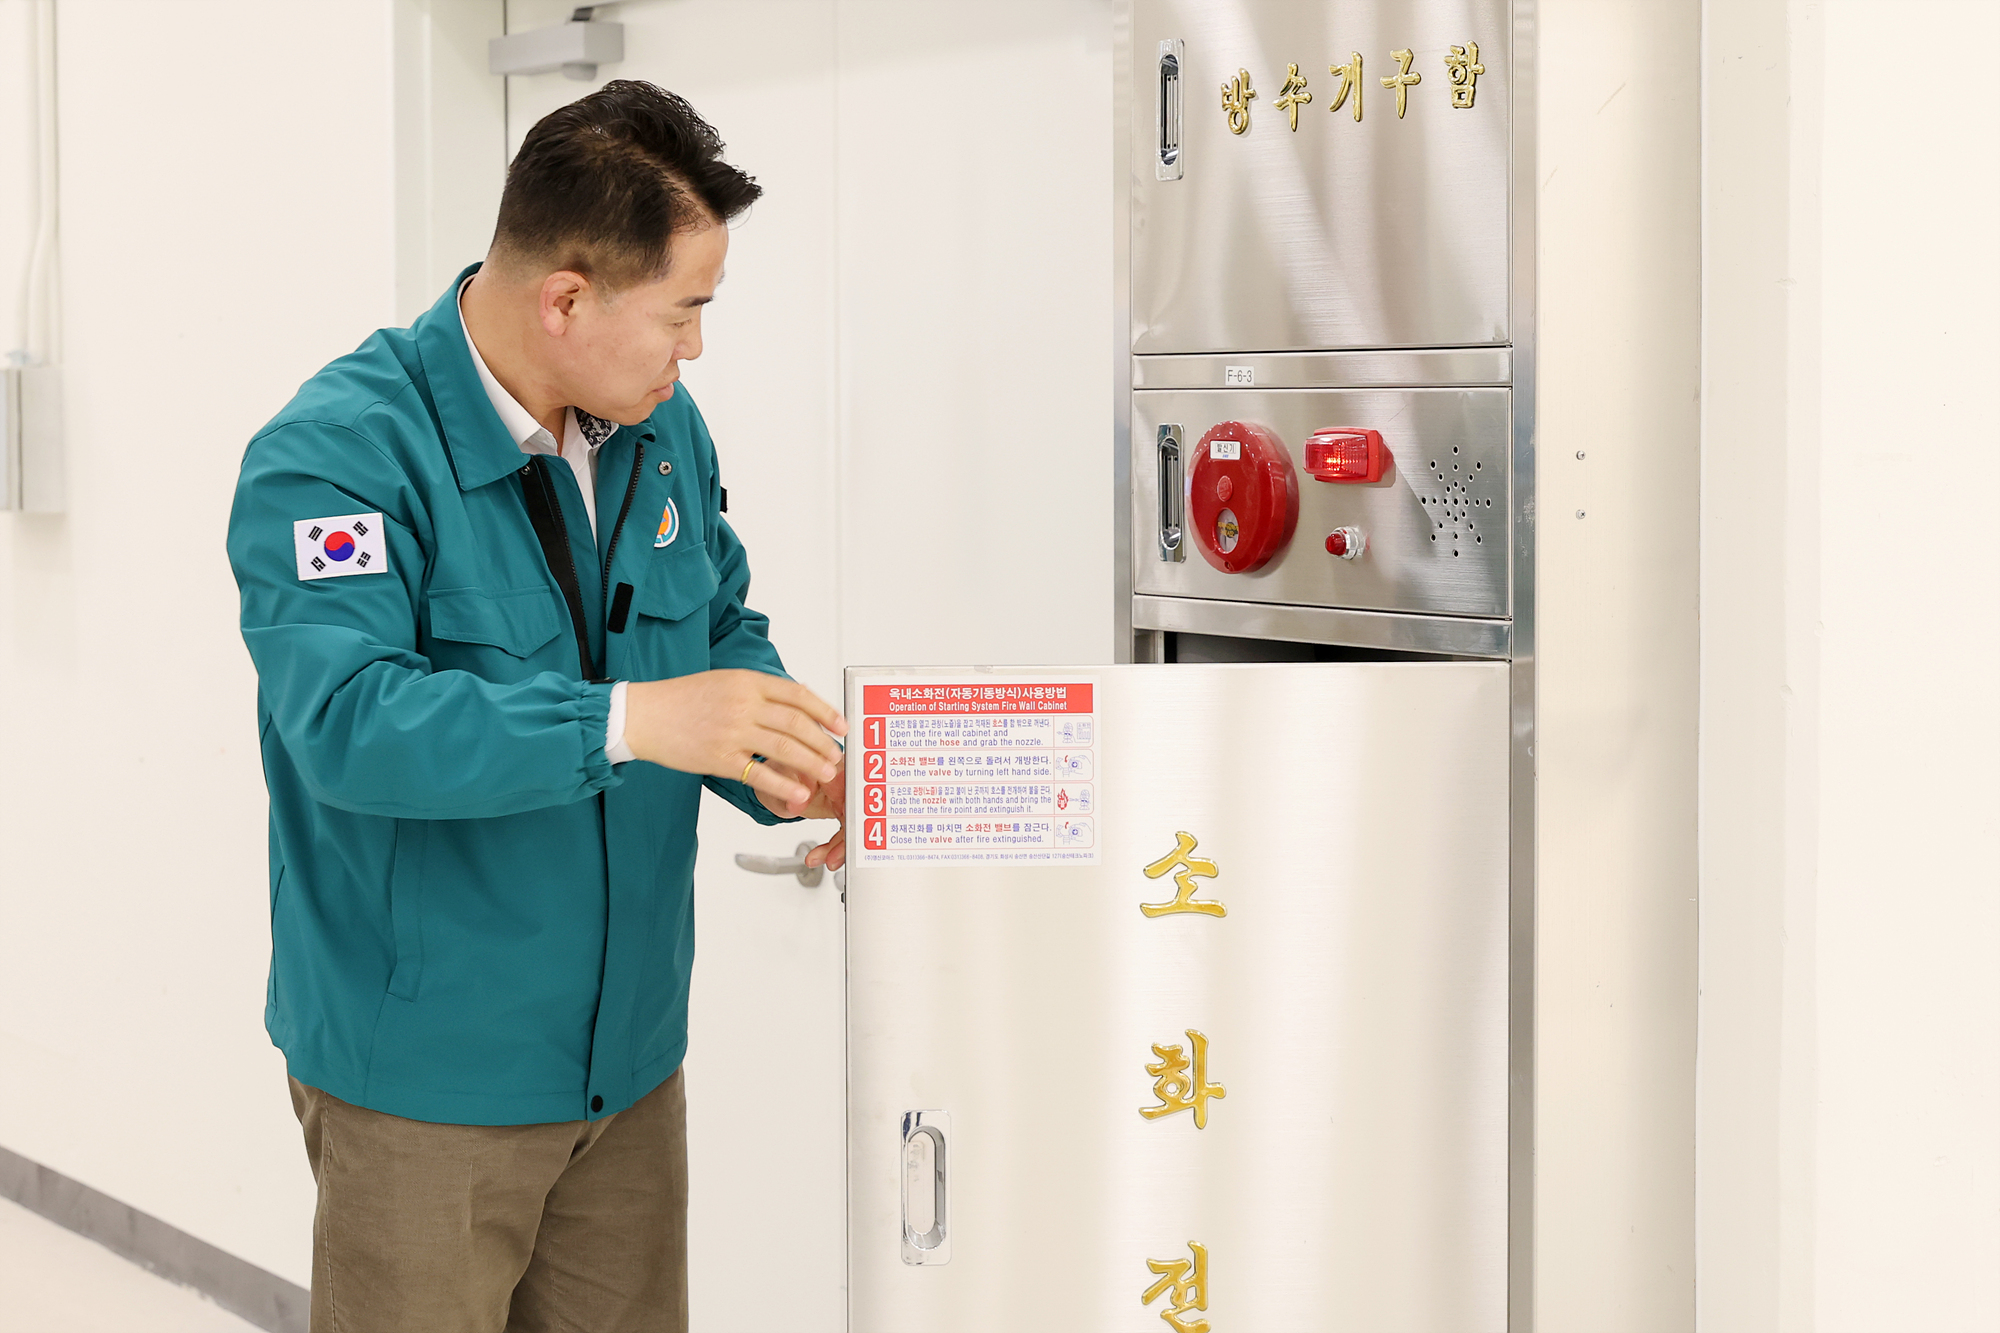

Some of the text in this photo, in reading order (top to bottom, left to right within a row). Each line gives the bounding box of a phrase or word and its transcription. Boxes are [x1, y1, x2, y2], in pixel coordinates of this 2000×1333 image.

[1221, 40, 1485, 135] 방수기구함
[1227, 369, 1252, 383] F-6-3
[889, 687, 1067, 700] 옥내소화전(자동기동방식)사용방법
[889, 701, 1067, 712] Operation of Starting System Fire Wall Cabinet
[869, 721, 880, 747] 1
[890, 730, 911, 738] Open
[914, 730, 926, 738] the
[928, 730, 942, 738] fire
[945, 729, 960, 737] wall
[962, 729, 991, 737] cabinet
[890, 739, 907, 747] take
[910, 739, 922, 747] out
[925, 739, 937, 747] the
[940, 738, 960, 746] hose
[980, 738, 998, 748] grab
[1000, 738, 1013, 746] the
[1016, 738, 1044, 746] nozzle.
[868, 754, 884, 779] 2
[890, 756, 1052, 766] 소화전 밸브를 왼쪽으로 돌려서 개방한다.
[890, 768, 1052, 778] Open the valve by turning left hand side.
[868, 787, 884, 813] 3
[890, 796, 908, 804] Grab
[910, 796, 920, 804] the
[966, 796, 980, 804] both
[982, 796, 1004, 804] hands
[1006, 796, 1018, 804] and
[1020, 796, 1038, 804] bring
[890, 806, 906, 814] hose
[940, 806, 952, 814] fire
[954, 806, 972, 814] point
[990, 805, 1024, 814] extinguish
[890, 822, 1052, 833] 화재진화를 마치면 소화전 밸브를 잠근다.
[868, 821, 884, 846] 4
[890, 836, 912, 844] Close
[930, 836, 952, 844] valve
[955, 835, 974, 844] after
[976, 835, 990, 843] fire
[992, 834, 1044, 844] extinguished.
[1139, 831, 1228, 1333] 소화전
